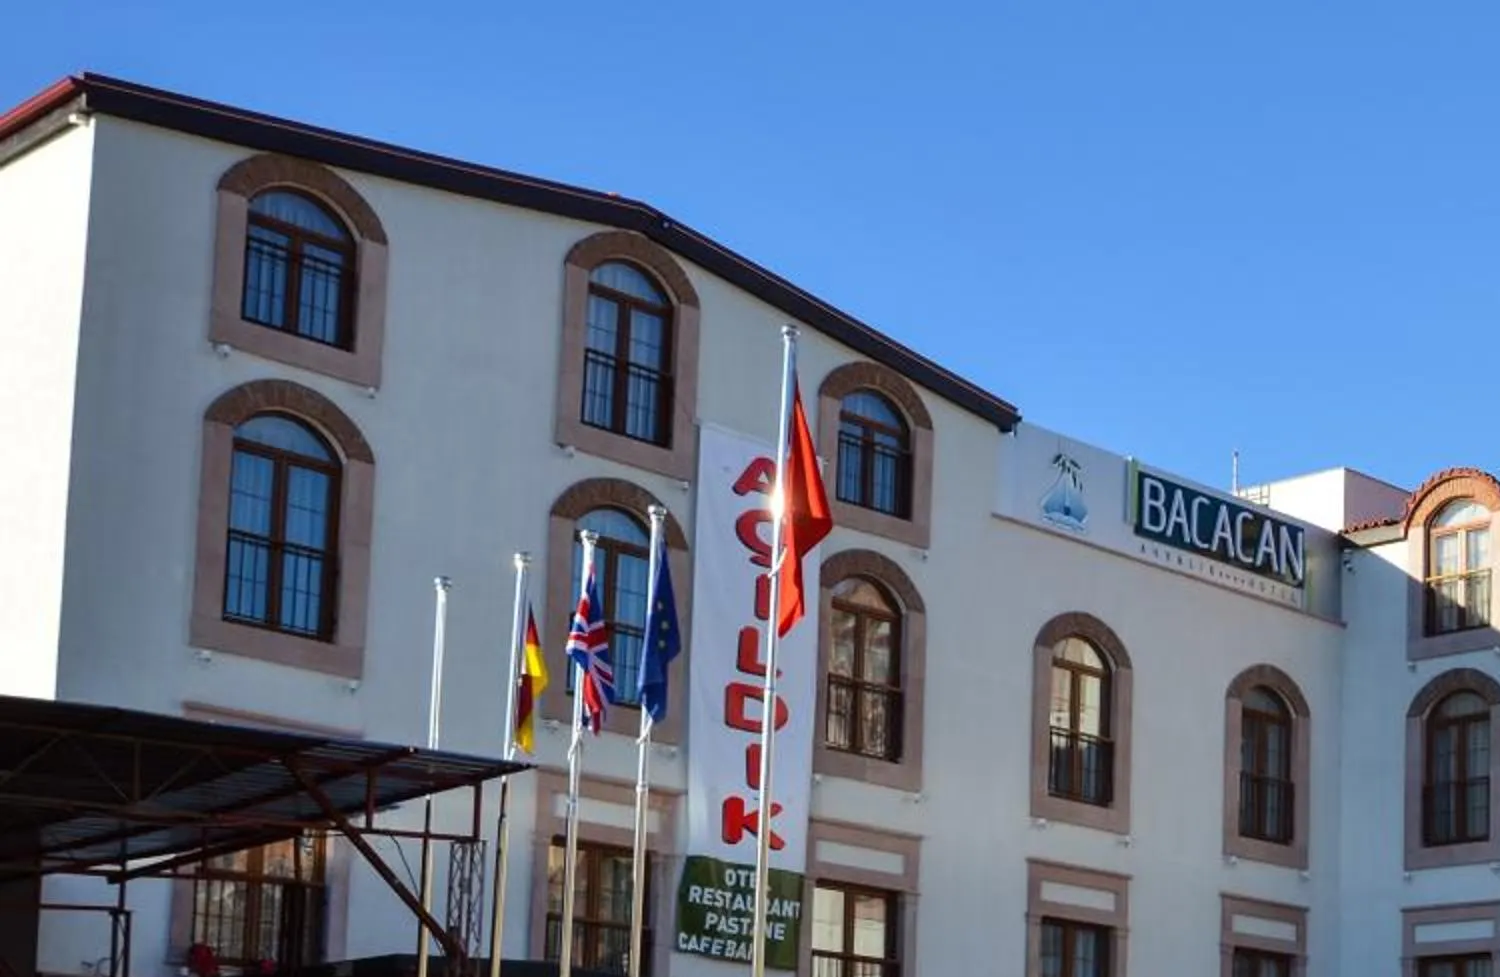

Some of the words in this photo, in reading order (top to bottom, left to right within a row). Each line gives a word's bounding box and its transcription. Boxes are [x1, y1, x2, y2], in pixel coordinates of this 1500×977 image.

[1142, 477, 1304, 582] BACACAN
[724, 868, 771, 891] OTE
[688, 885, 801, 920] RESTAUANT
[704, 911, 787, 941] PASTNE
